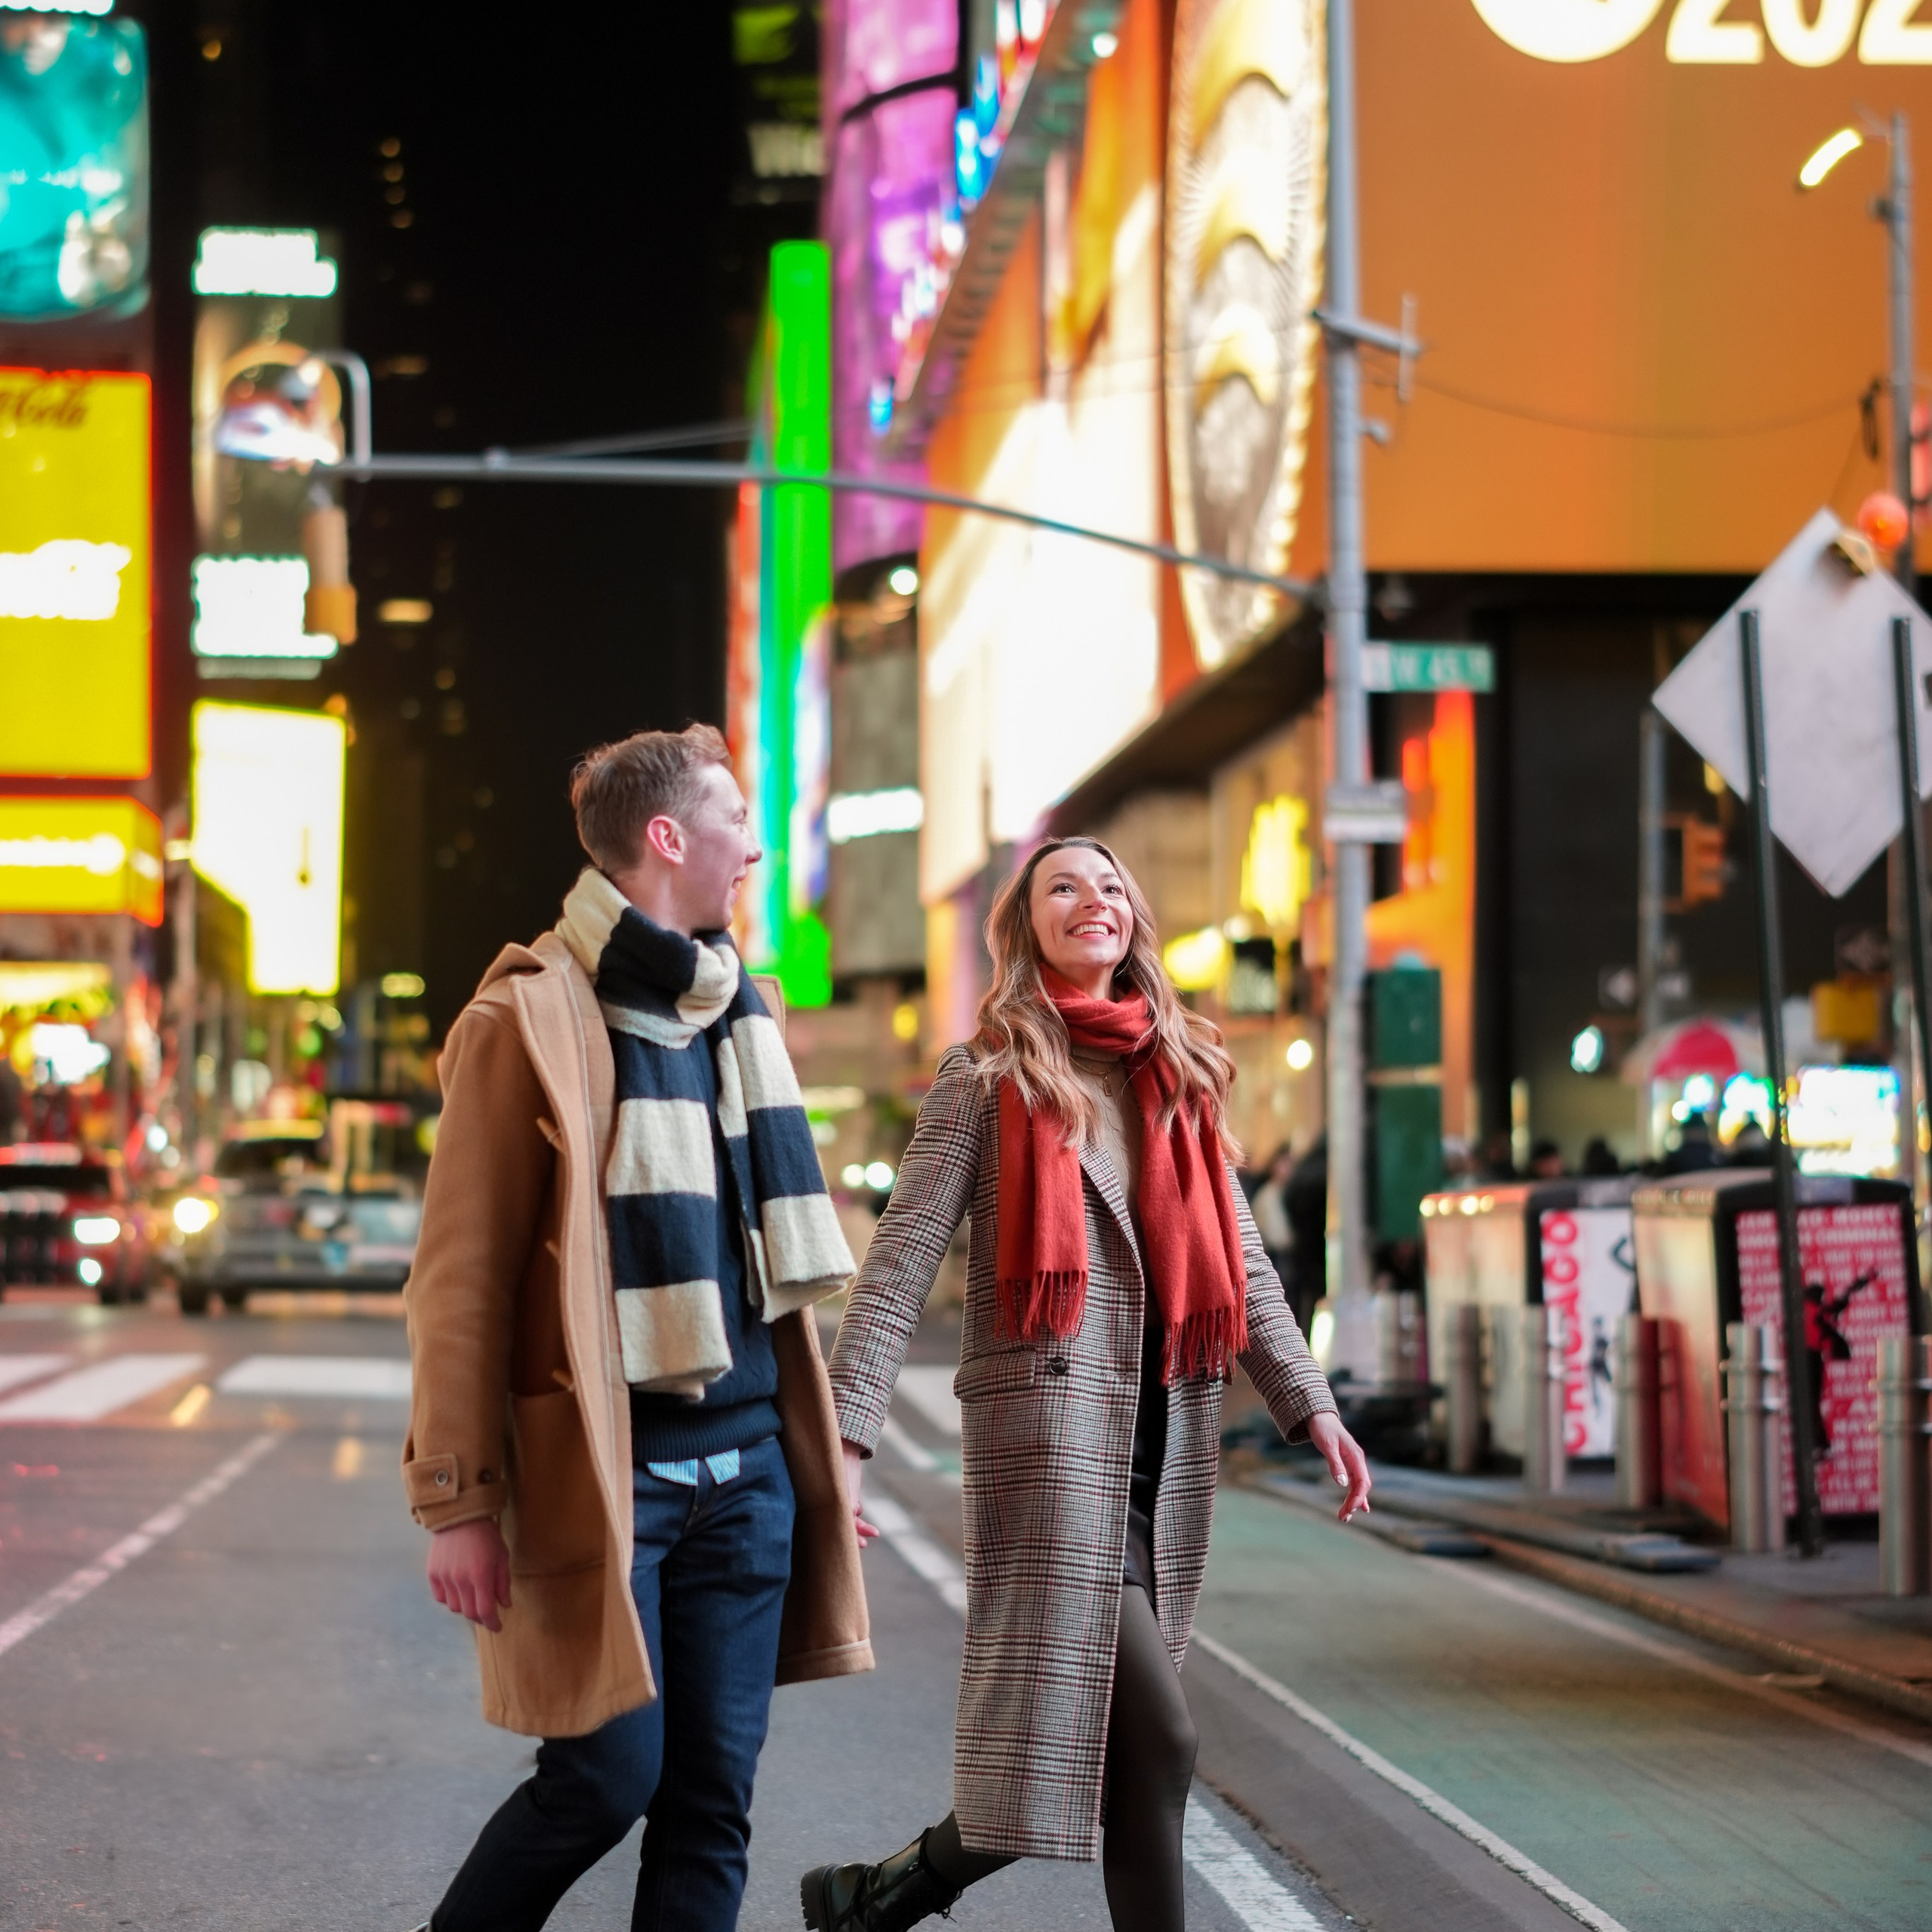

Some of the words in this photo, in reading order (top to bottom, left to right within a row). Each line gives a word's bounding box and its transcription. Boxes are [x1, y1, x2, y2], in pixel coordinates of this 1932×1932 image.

[1832, 1205, 1899, 1225] MONEY
[1815, 1226, 1901, 1246] CRIMINAL
[1542, 1211, 1586, 1454] CHICAGO
